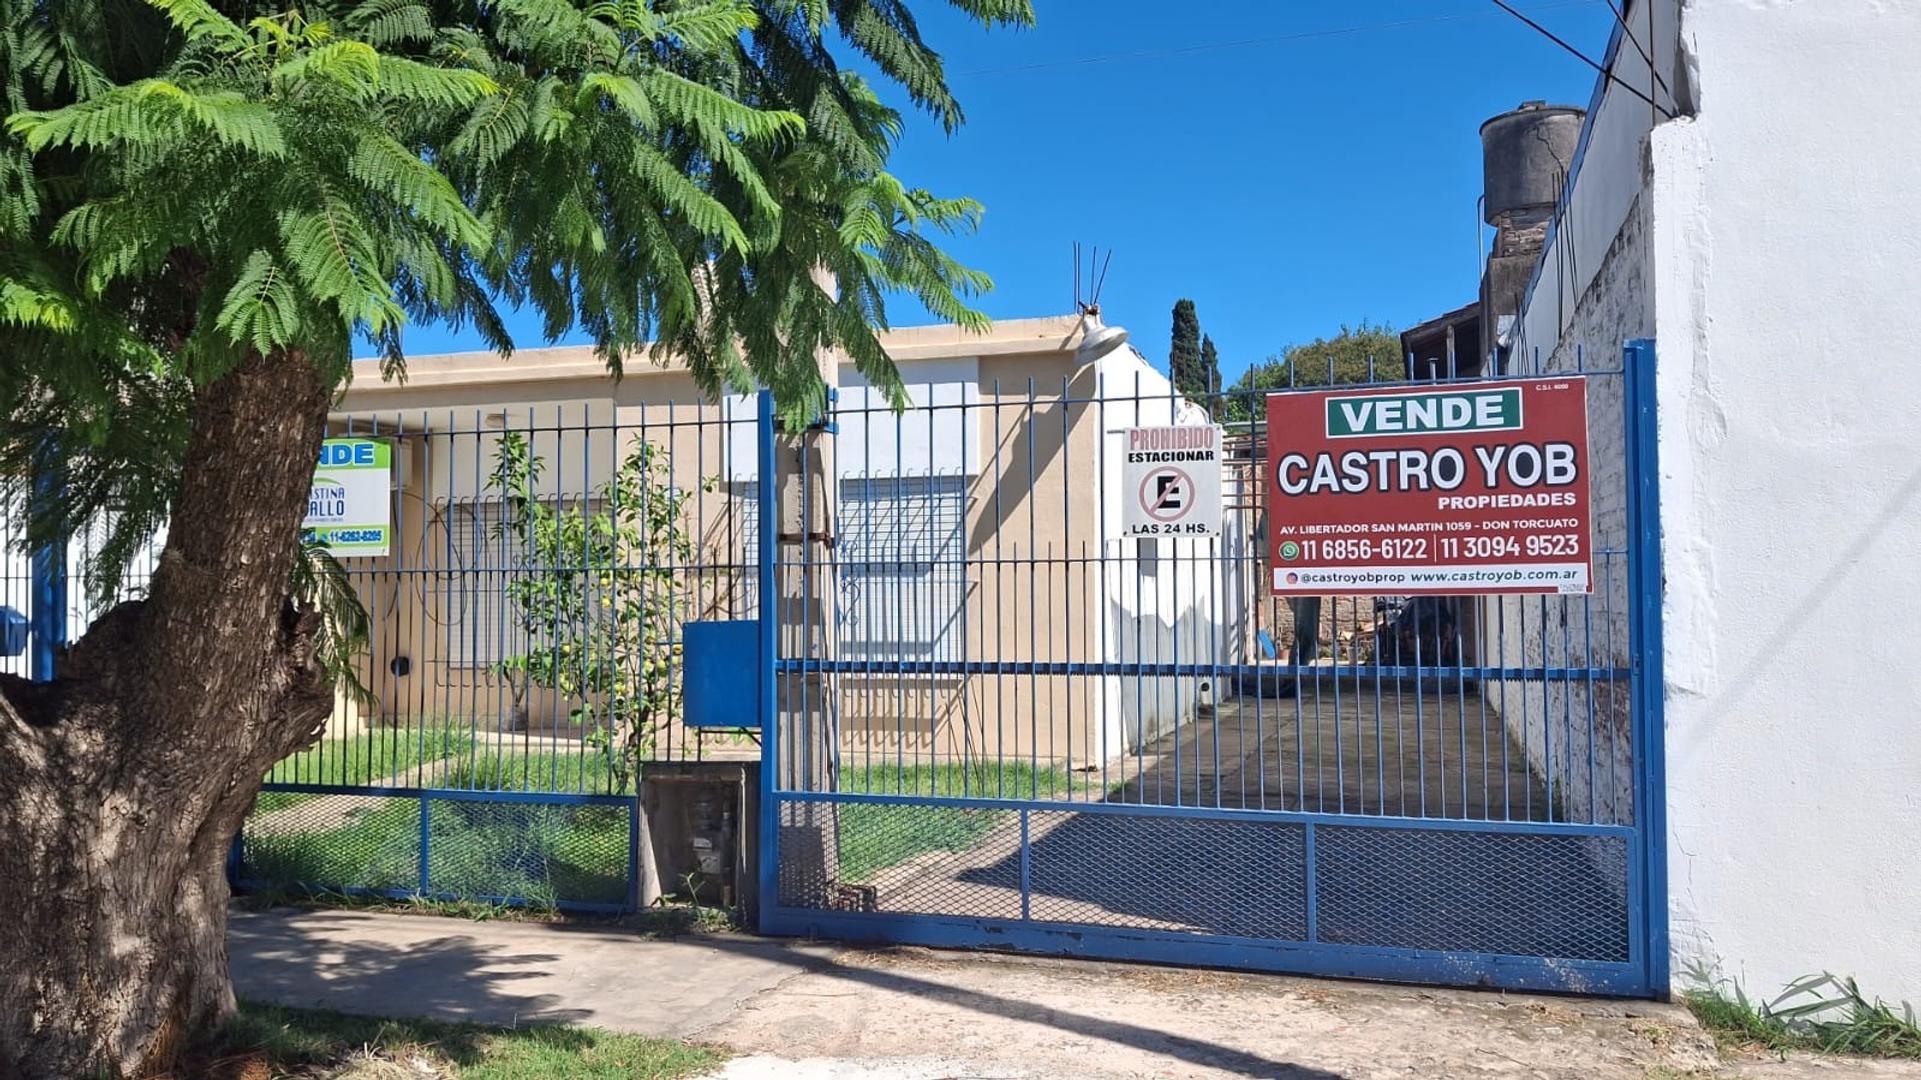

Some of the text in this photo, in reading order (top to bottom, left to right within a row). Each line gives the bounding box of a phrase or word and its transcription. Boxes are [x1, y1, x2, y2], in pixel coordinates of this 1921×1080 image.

[1340, 394, 1505, 433] VENDE
[1130, 427, 1214, 450] PROHIBIDO
[1128, 451, 1214, 463] ESTACIONAR
[1278, 443, 1578, 495] CASTRO YOB
[1437, 493, 1576, 510] PROPIEDADES
[1132, 523, 1210, 534] LAS 24 HS.
[1280, 526, 1298, 535] AV.
[1299, 523, 1369, 534] LIBERTADOR
[1371, 523, 1395, 533] SAN
[1397, 521, 1443, 532] MARTIN
[1446, 521, 1472, 531] 1059
[1482, 520, 1510, 530] DON
[1513, 518, 1579, 529] TORCUATO
[1301, 538, 1428, 560] 11 6856-6122
[1440, 534, 1579, 558] 11 3094 9523
[1301, 569, 1578, 584] @castroyobprop www.castroyob.com.ar
